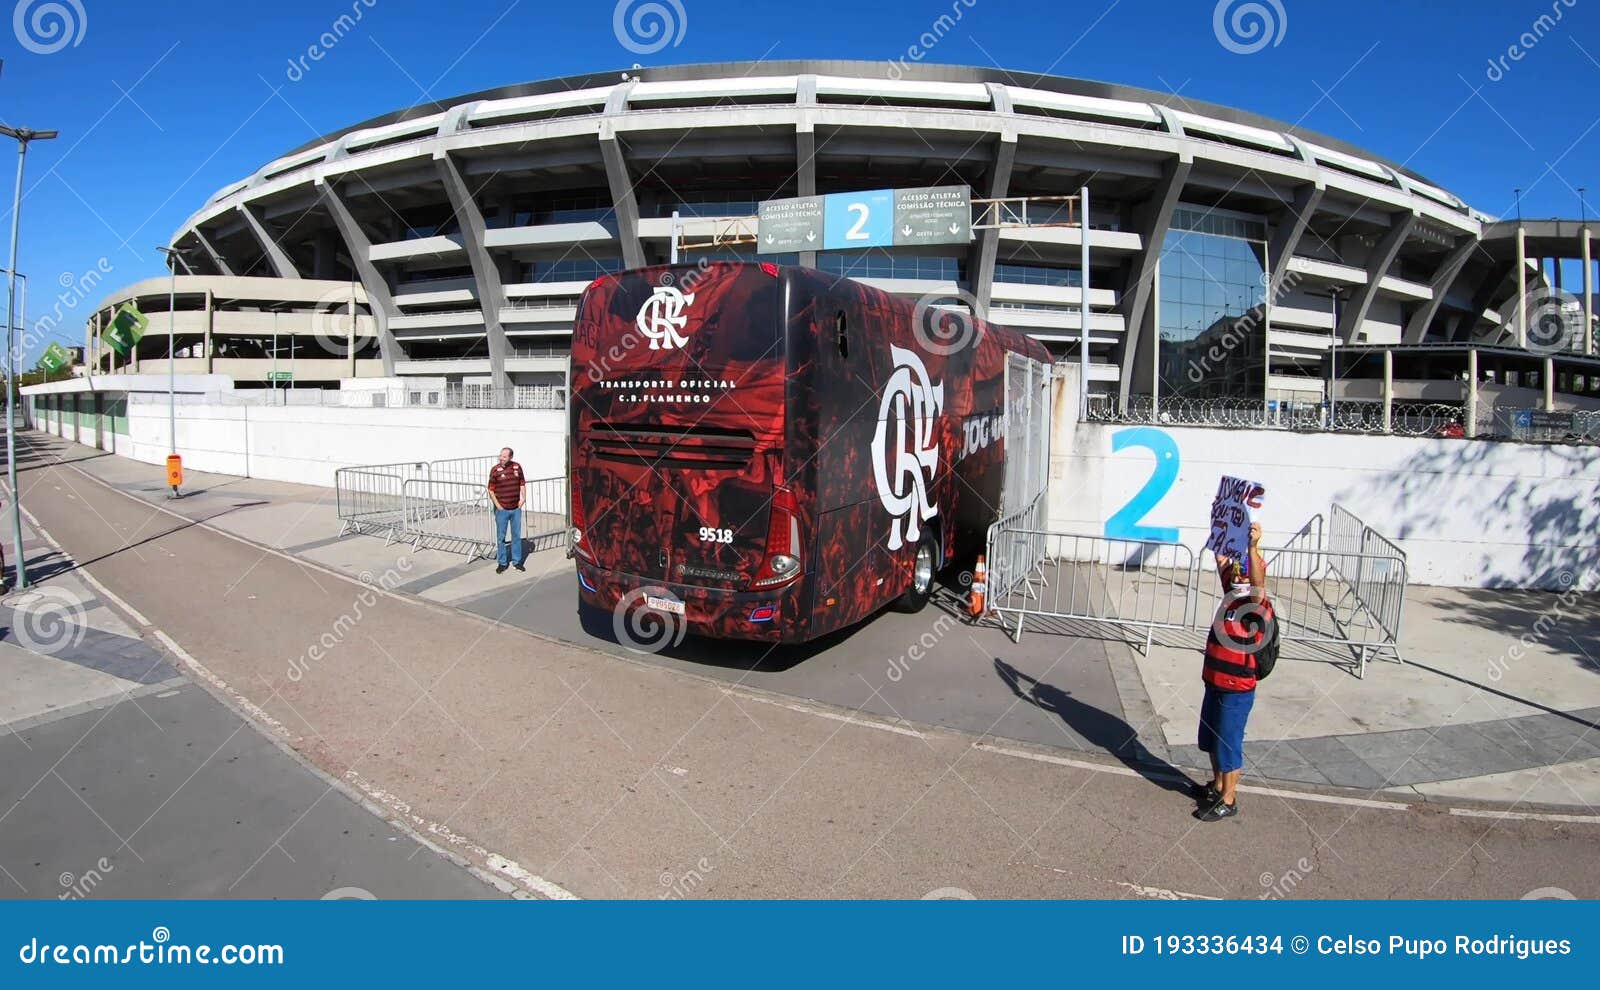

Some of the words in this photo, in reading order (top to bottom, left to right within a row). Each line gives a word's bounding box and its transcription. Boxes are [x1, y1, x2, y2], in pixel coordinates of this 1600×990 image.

[930, 192, 961, 200] ATLETAS
[897, 201, 934, 210] COMISSÃO
[846, 202, 870, 241] 2
[110, 328, 128, 347] F
[43, 355, 55, 369] F
[600, 380, 673, 389] TRANSPORTE
[680, 380, 737, 389] OFICIAL
[1104, 426, 1180, 542] 2
[698, 526, 734, 544] 9518
